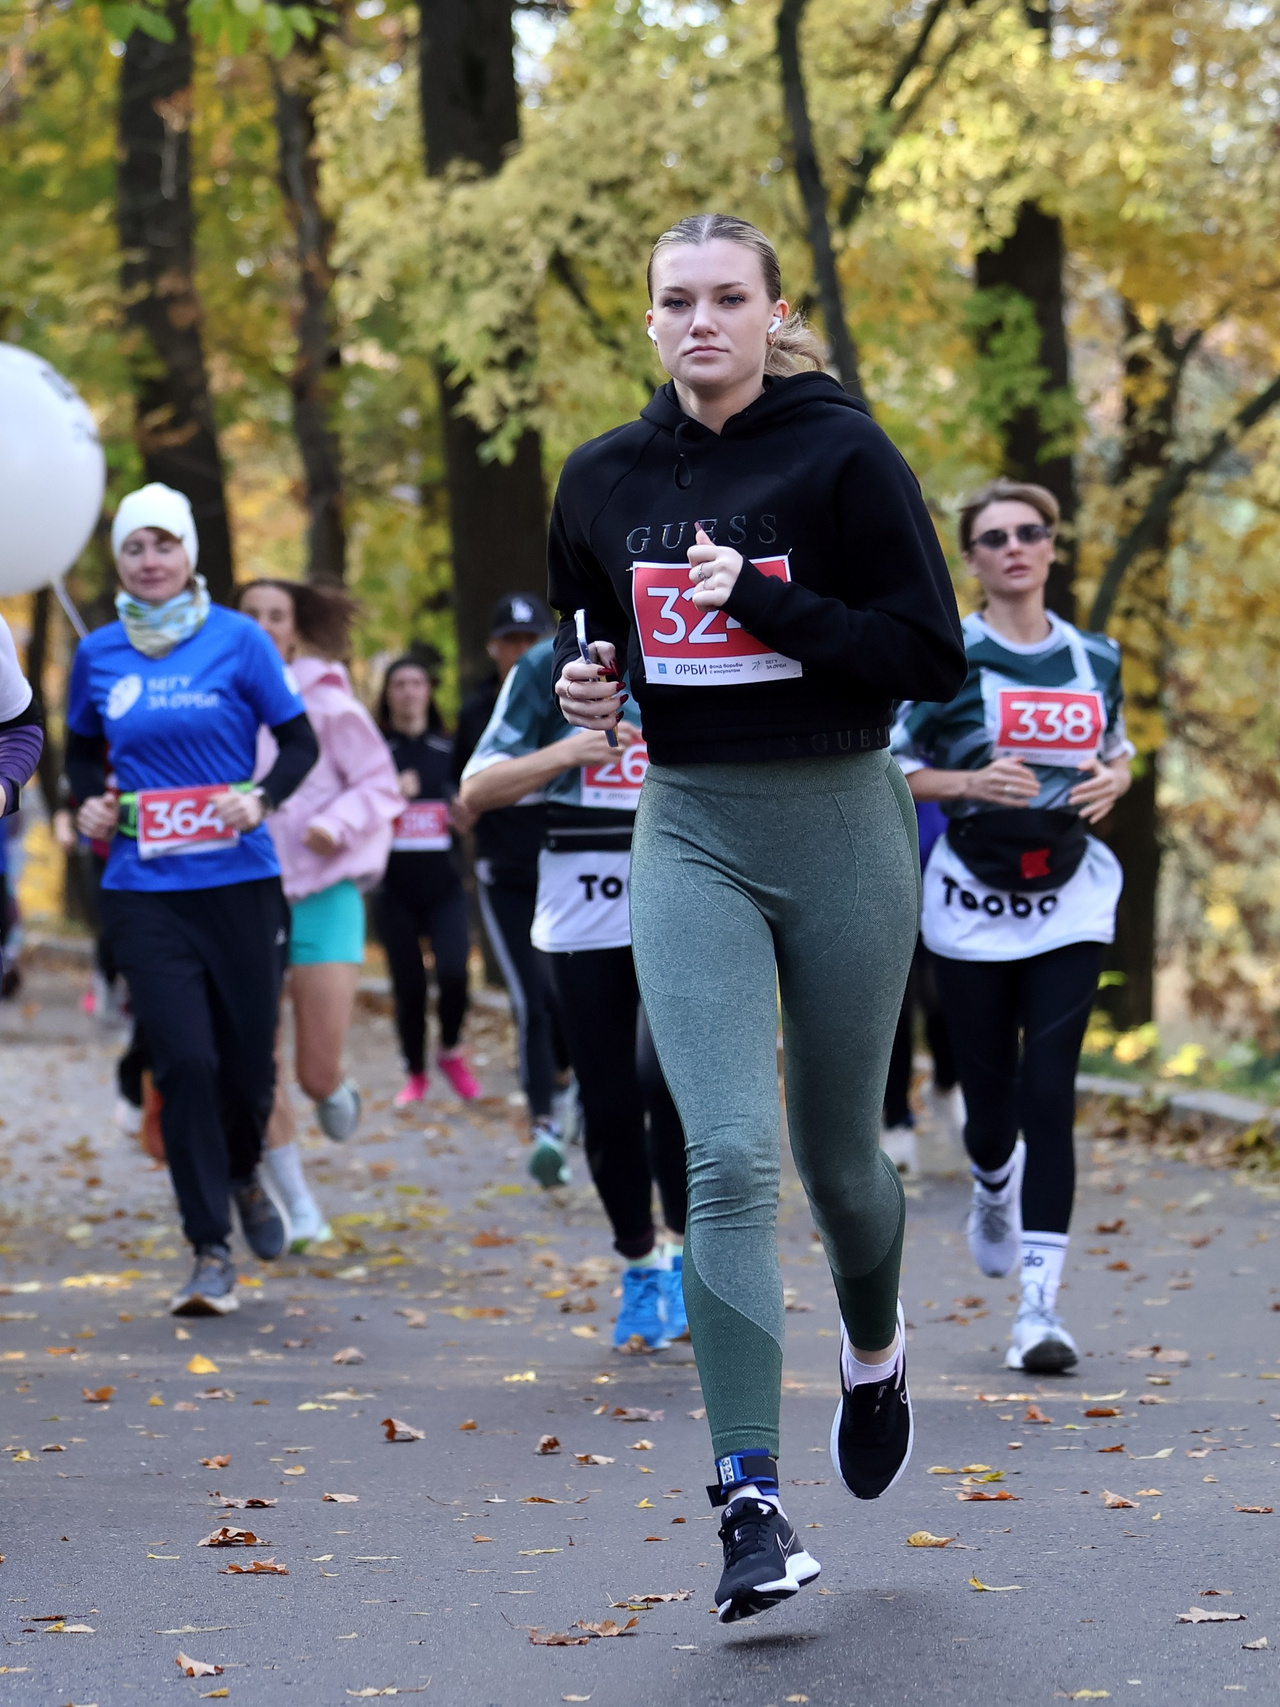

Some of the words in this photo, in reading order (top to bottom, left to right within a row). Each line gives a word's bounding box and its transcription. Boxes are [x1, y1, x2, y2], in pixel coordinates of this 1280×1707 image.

[625, 514, 777, 554] GUESS
[646, 586, 742, 645] 32
[675, 663, 708, 675] ОРБИ
[1009, 700, 1093, 743] 338
[145, 798, 224, 839] 364
[721, 1458, 733, 1481] 324
